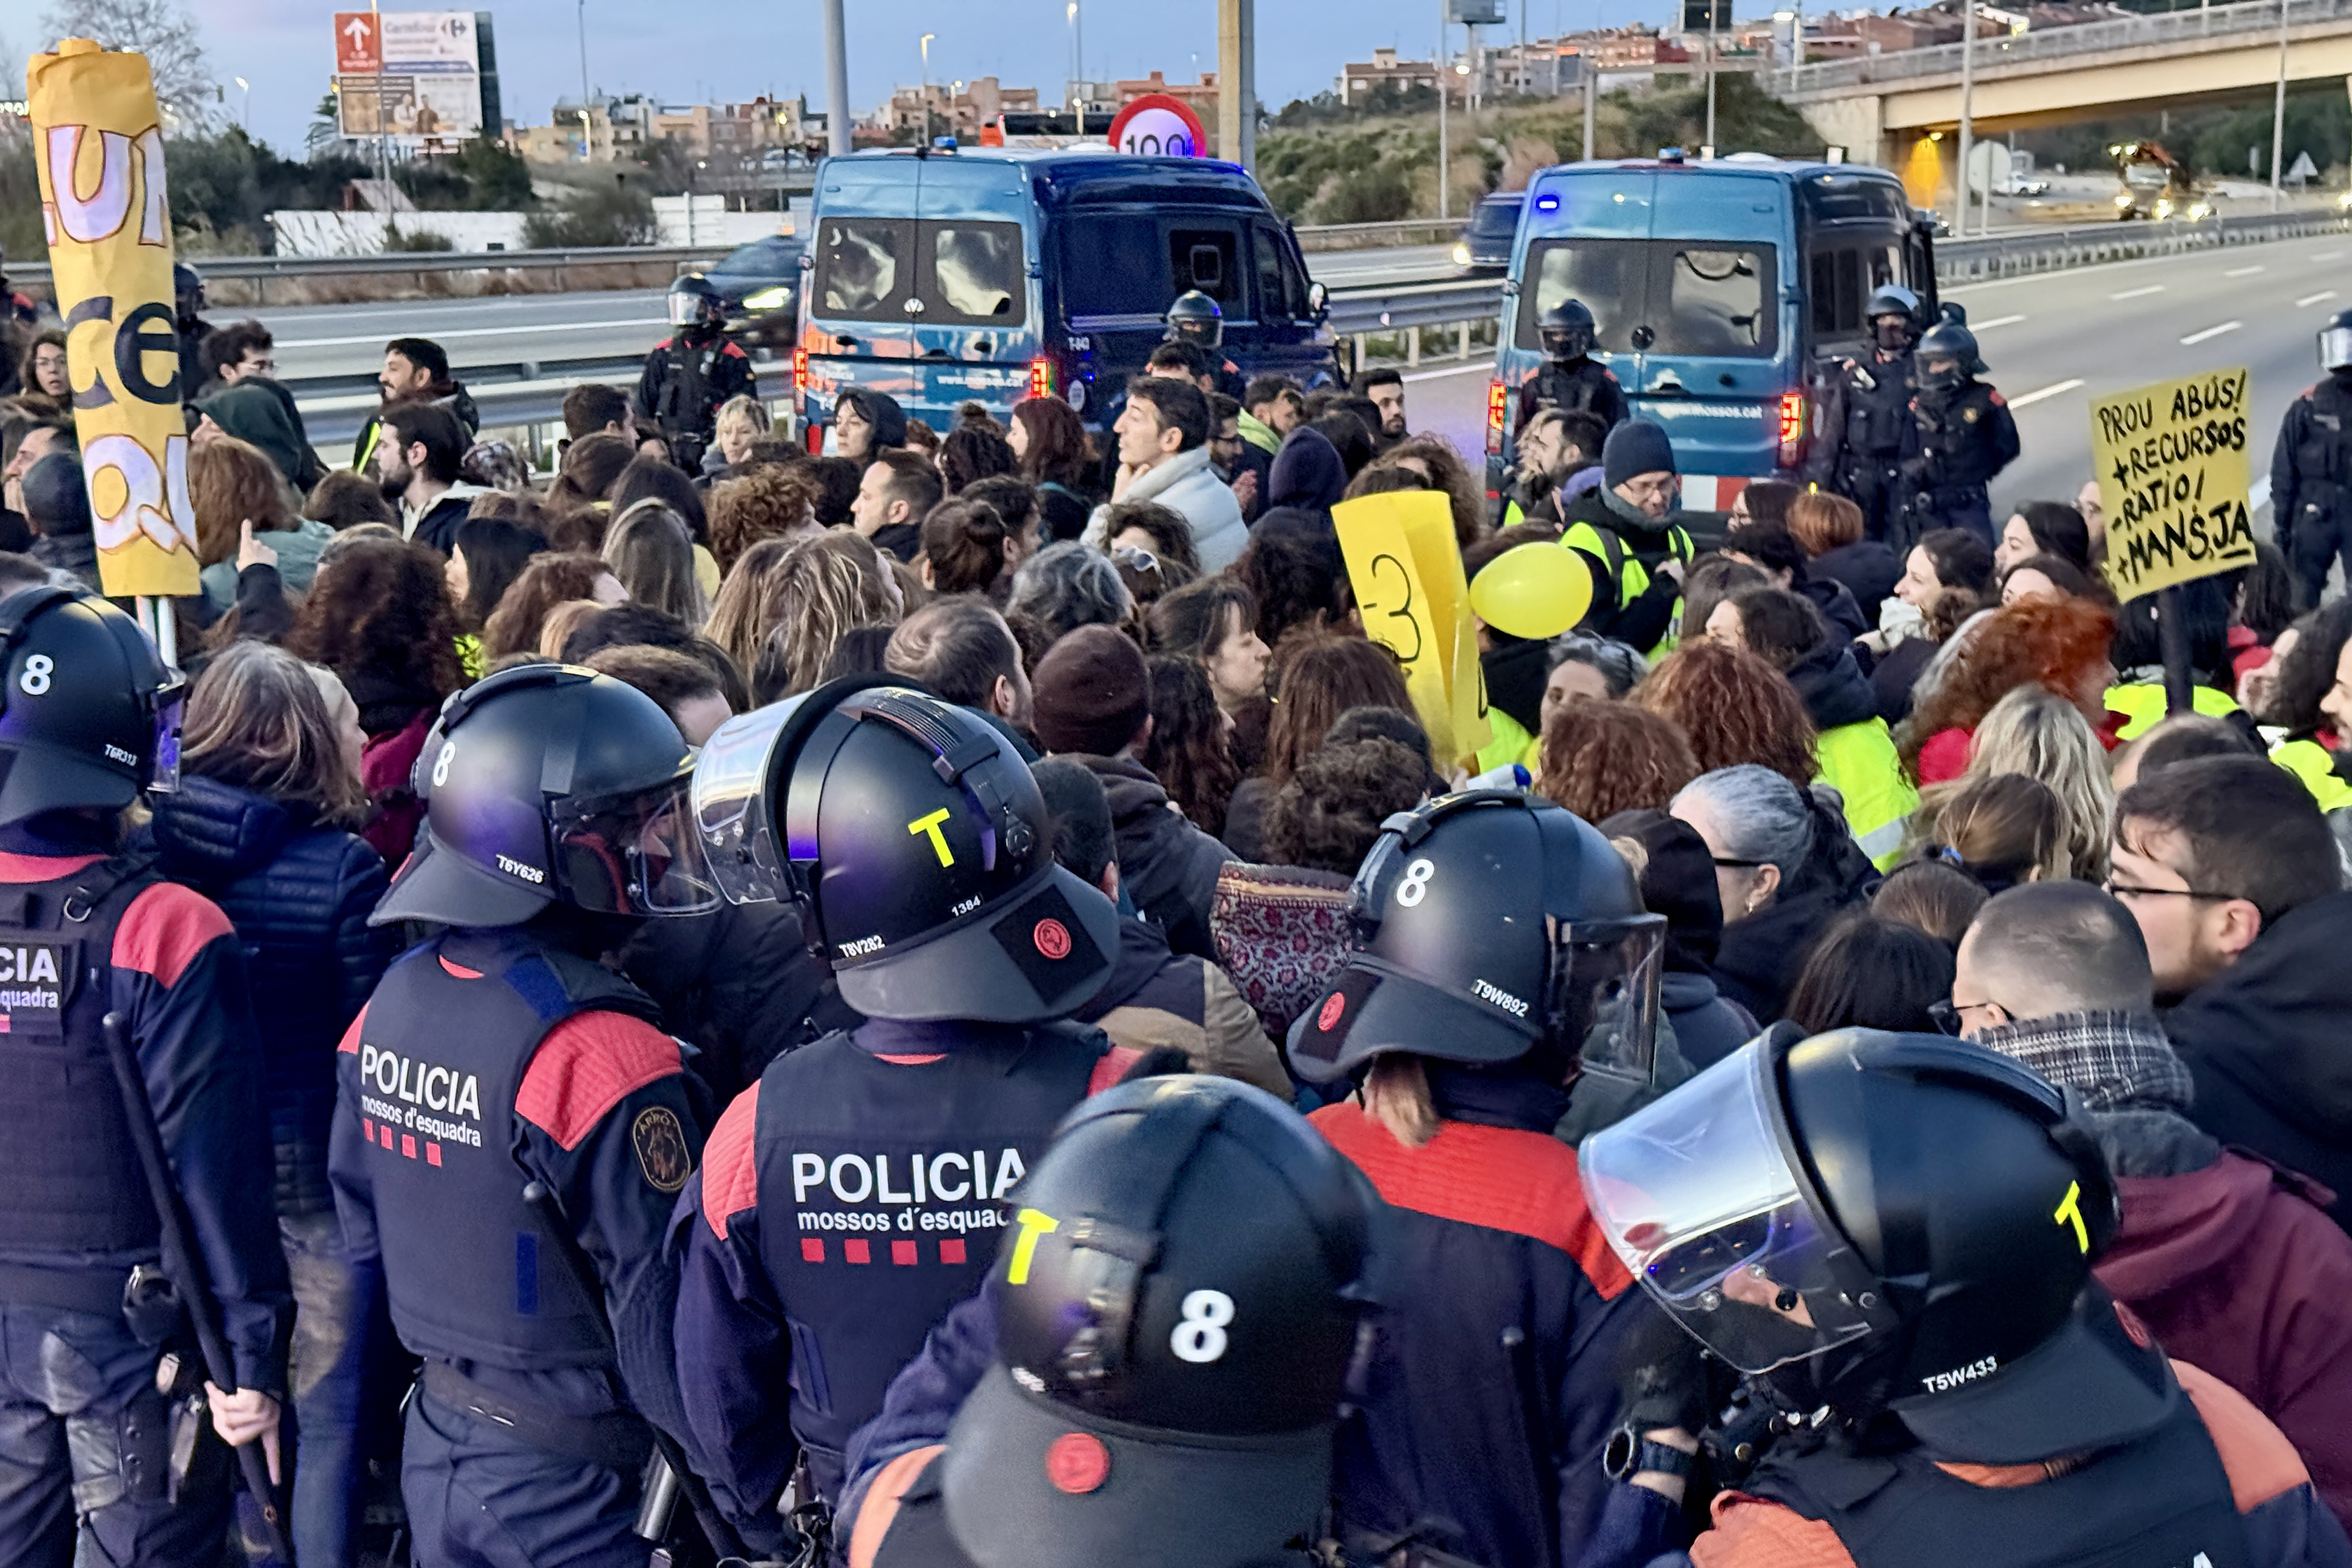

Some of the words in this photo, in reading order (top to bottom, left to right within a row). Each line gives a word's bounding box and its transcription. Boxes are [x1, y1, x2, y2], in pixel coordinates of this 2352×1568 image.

[1126, 134, 1185, 156] 100
[2097, 397, 2153, 445] PROU
[20, 653, 54, 695] 8
[433, 741, 456, 787] 8
[908, 807, 955, 868] T
[496, 853, 544, 884] T6Y626
[1396, 855, 1435, 908] 8
[951, 895, 981, 917] 1384
[838, 935, 886, 958] T8V282
[1474, 978, 1529, 1017] T9W892
[362, 1044, 481, 1121] POLICIA
[405, 1107, 481, 1147] d'esquadra
[792, 1148, 1027, 1203] POLICIA
[797, 1211, 890, 1231] mossos
[2054, 1179, 2090, 1254] T
[1007, 1208, 1059, 1285] T
[1170, 1289, 1235, 1363] 8
[1923, 1354, 1999, 1394] T5W433
